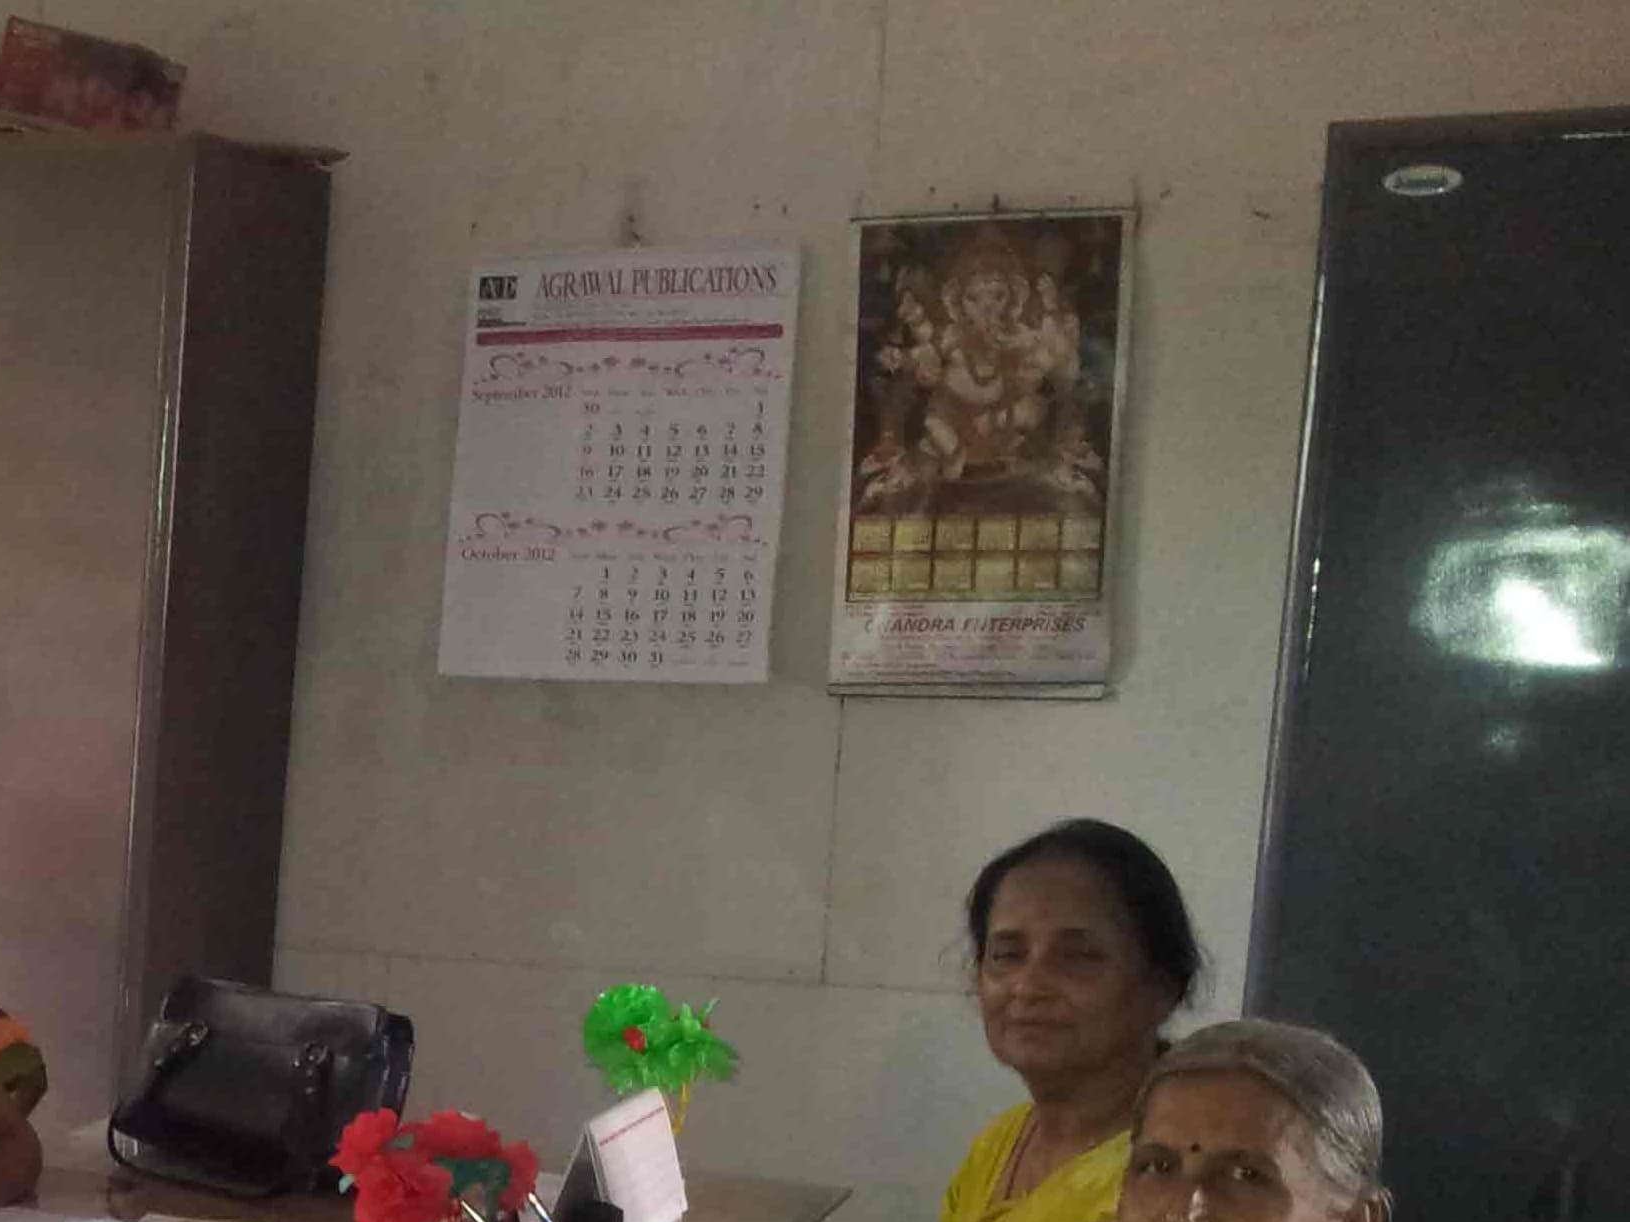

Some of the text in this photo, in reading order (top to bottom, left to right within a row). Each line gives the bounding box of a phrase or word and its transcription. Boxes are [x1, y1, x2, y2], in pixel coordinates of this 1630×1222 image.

[537, 271, 623, 298] AGRAWAL
[631, 266, 778, 296] PUBLICATIONS
[608, 444, 625, 457] 10
[636, 445, 652, 457] 11
[665, 445, 684, 457] 12
[694, 444, 710, 457] 13
[722, 444, 739, 457] 14
[608, 465, 624, 478] 17
[636, 466, 652, 478] 18
[692, 465, 710, 479] 20
[720, 465, 738, 479] 21
[602, 485, 621, 499] 24
[660, 486, 680, 500] 26
[689, 486, 708, 500] 27
[744, 485, 764, 499] 29
[460, 546, 519, 561] October
[522, 546, 556, 561] 2012
[653, 588, 671, 601] 10
[682, 589, 698, 602] 11
[712, 588, 728, 602] 12
[739, 589, 756, 602] 13
[596, 608, 612, 620] 15
[624, 608, 641, 621] 16
[652, 608, 668, 622] 17
[681, 610, 697, 622] 18
[710, 610, 726, 622] 19
[737, 610, 755, 622] 20
[591, 628, 611, 641] 22
[619, 629, 639, 642] 23
[675, 630, 697, 643] 25
[703, 630, 726, 643] 26
[590, 649, 609, 662] 29
